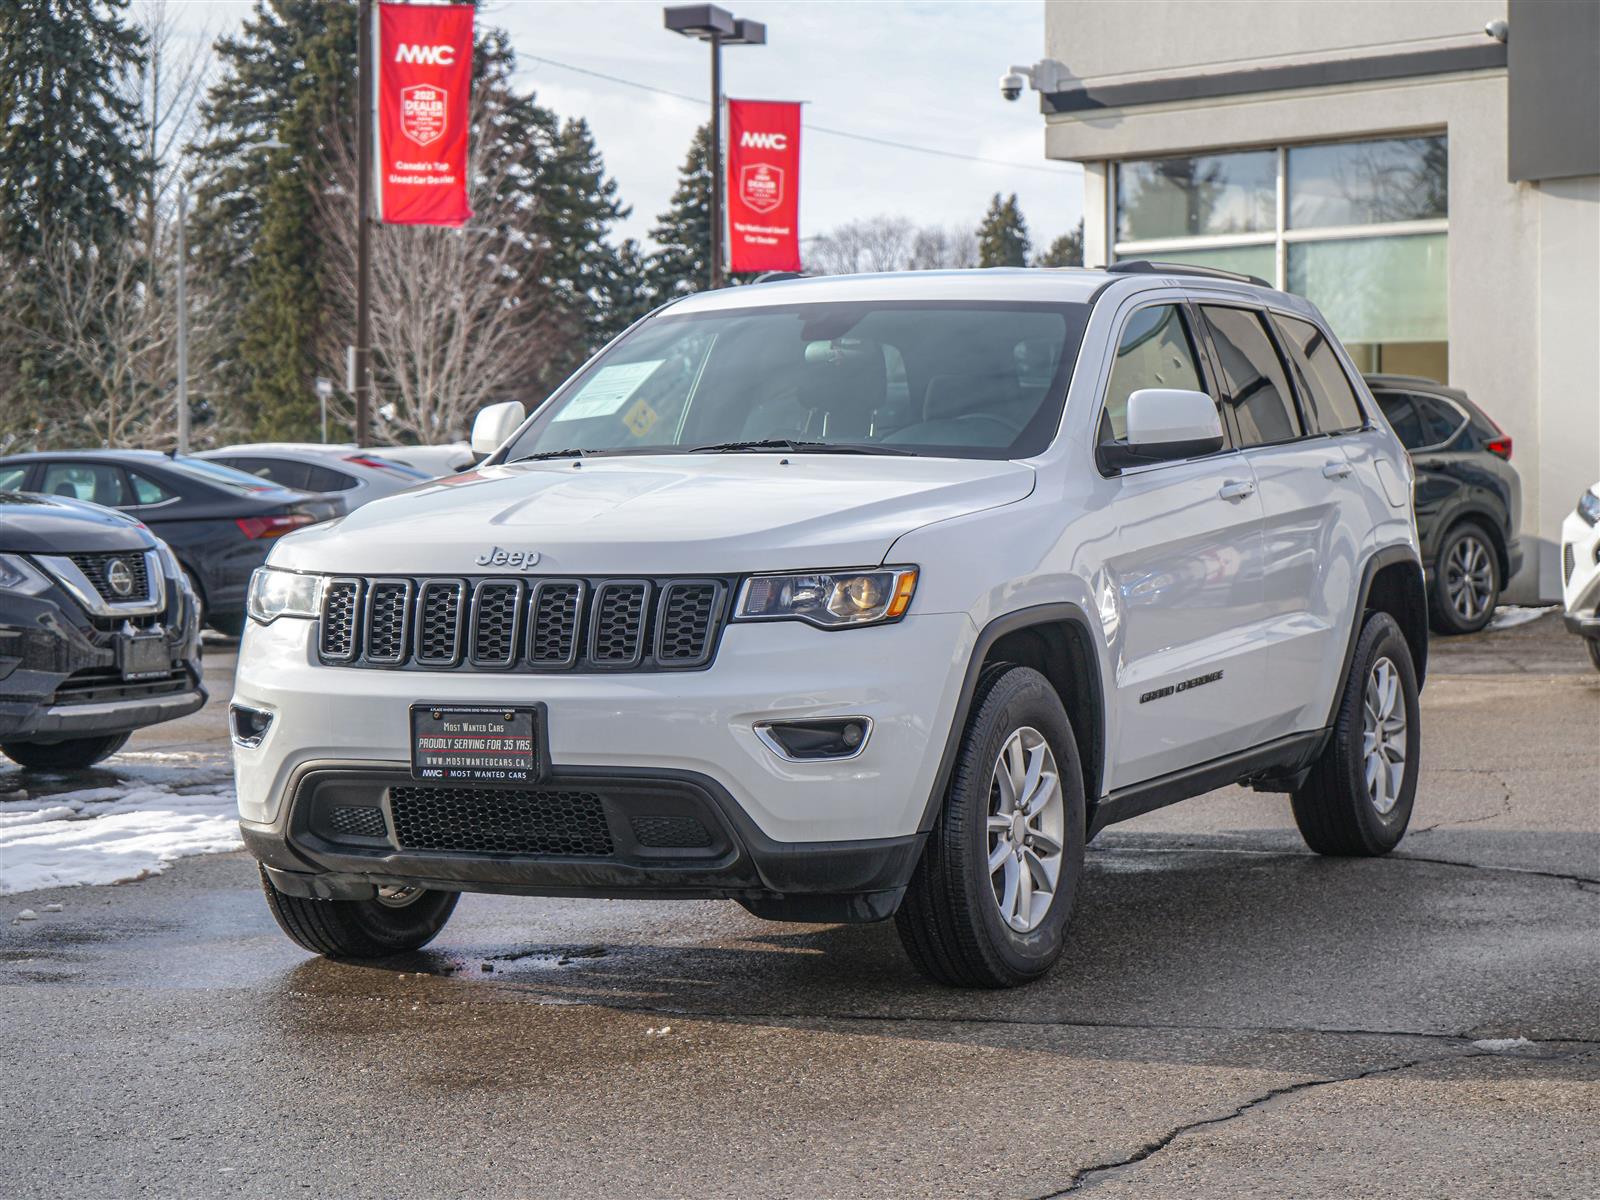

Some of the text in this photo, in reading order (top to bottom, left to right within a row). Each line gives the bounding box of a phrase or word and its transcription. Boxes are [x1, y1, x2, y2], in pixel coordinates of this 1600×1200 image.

[395, 43, 455, 65] MWC
[404, 100, 443, 111] DEALER
[740, 131, 787, 150] MWC
[475, 546, 541, 571] Jeep
[1139, 669, 1224, 704] GRAND CHEROKEE
[418, 738, 532, 750] PROUDLY SERVING FOR 35 YRS.
[426, 757, 525, 767] WWW.MOSTWANTEDCARS.CA
[450, 770, 471, 778] MOST
[508, 771, 527, 779] CARS
